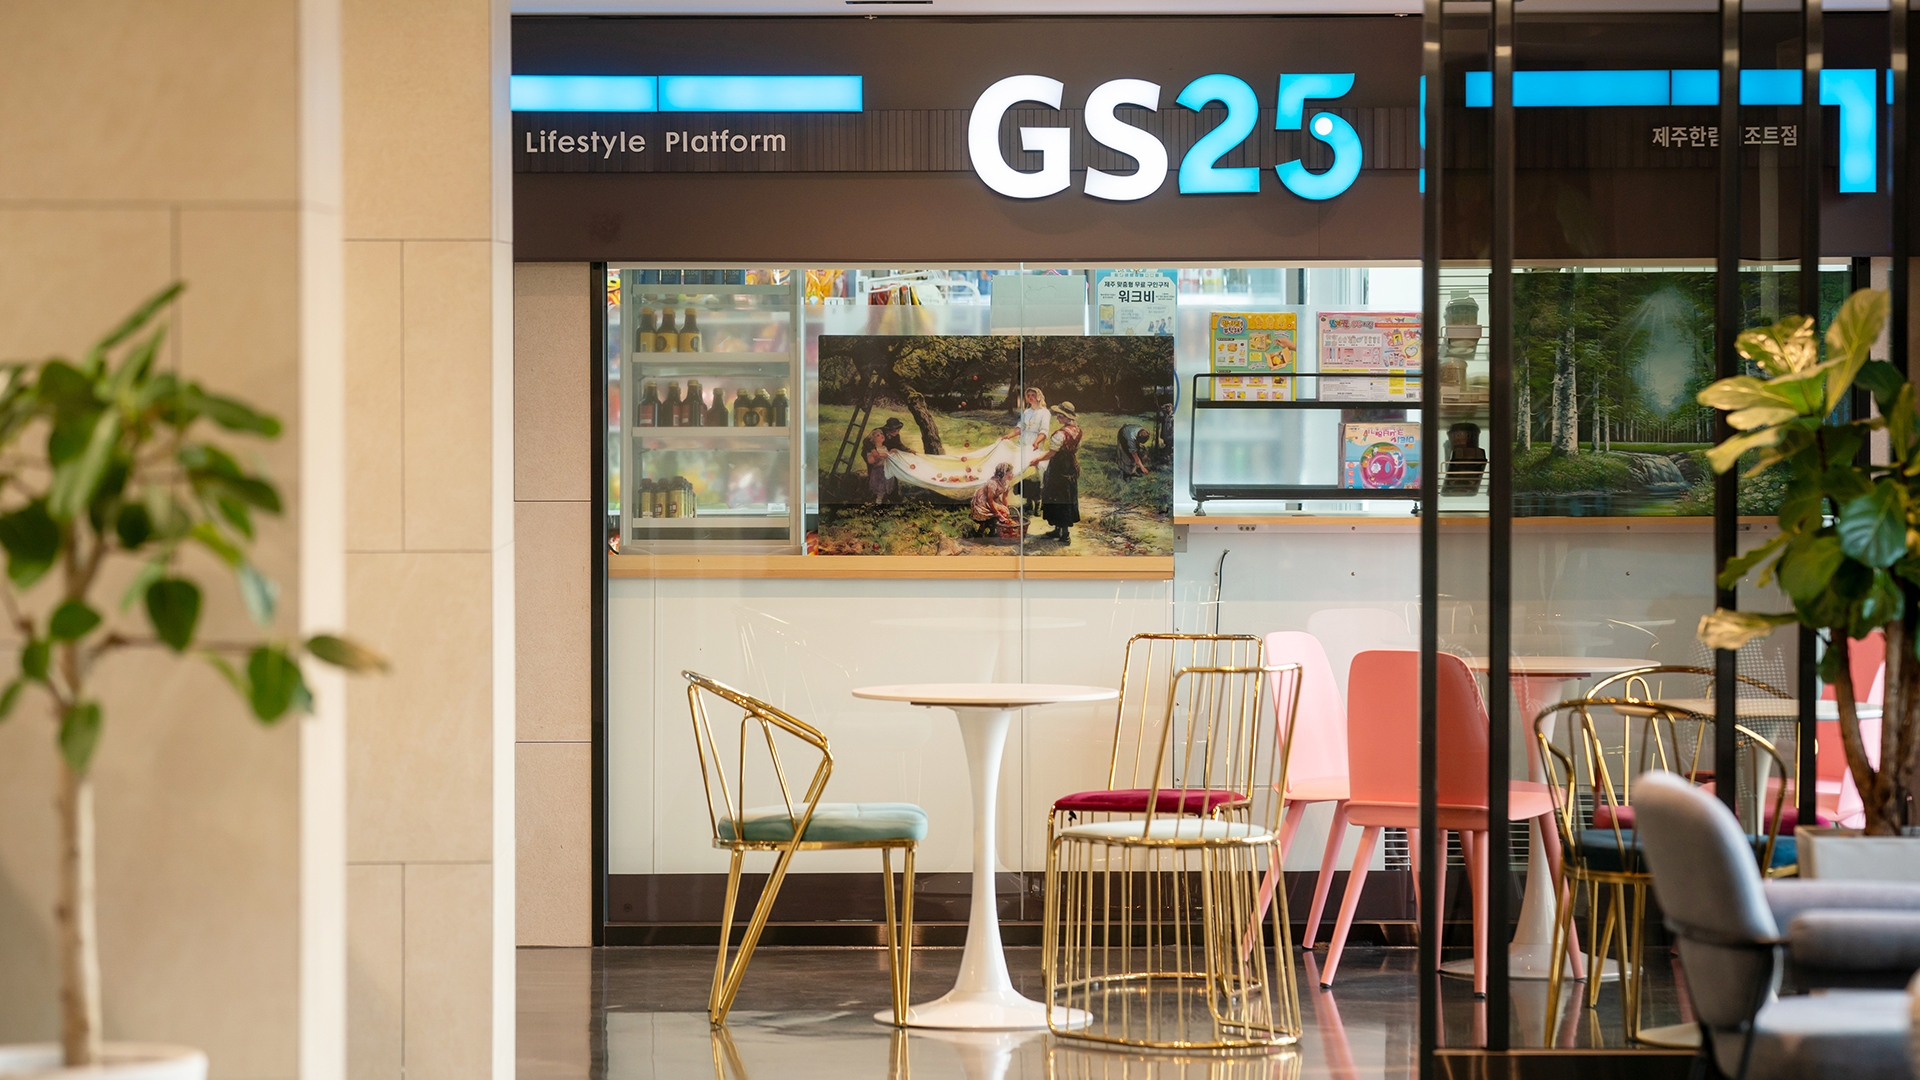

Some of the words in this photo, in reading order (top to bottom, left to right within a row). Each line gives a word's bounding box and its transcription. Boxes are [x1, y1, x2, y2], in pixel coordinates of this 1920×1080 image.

[526, 130, 646, 159] Lifestyle
[665, 129, 786, 153] Platform
[967, 73, 1363, 200] GS25
[1118, 290, 1155, 303] 워크비
